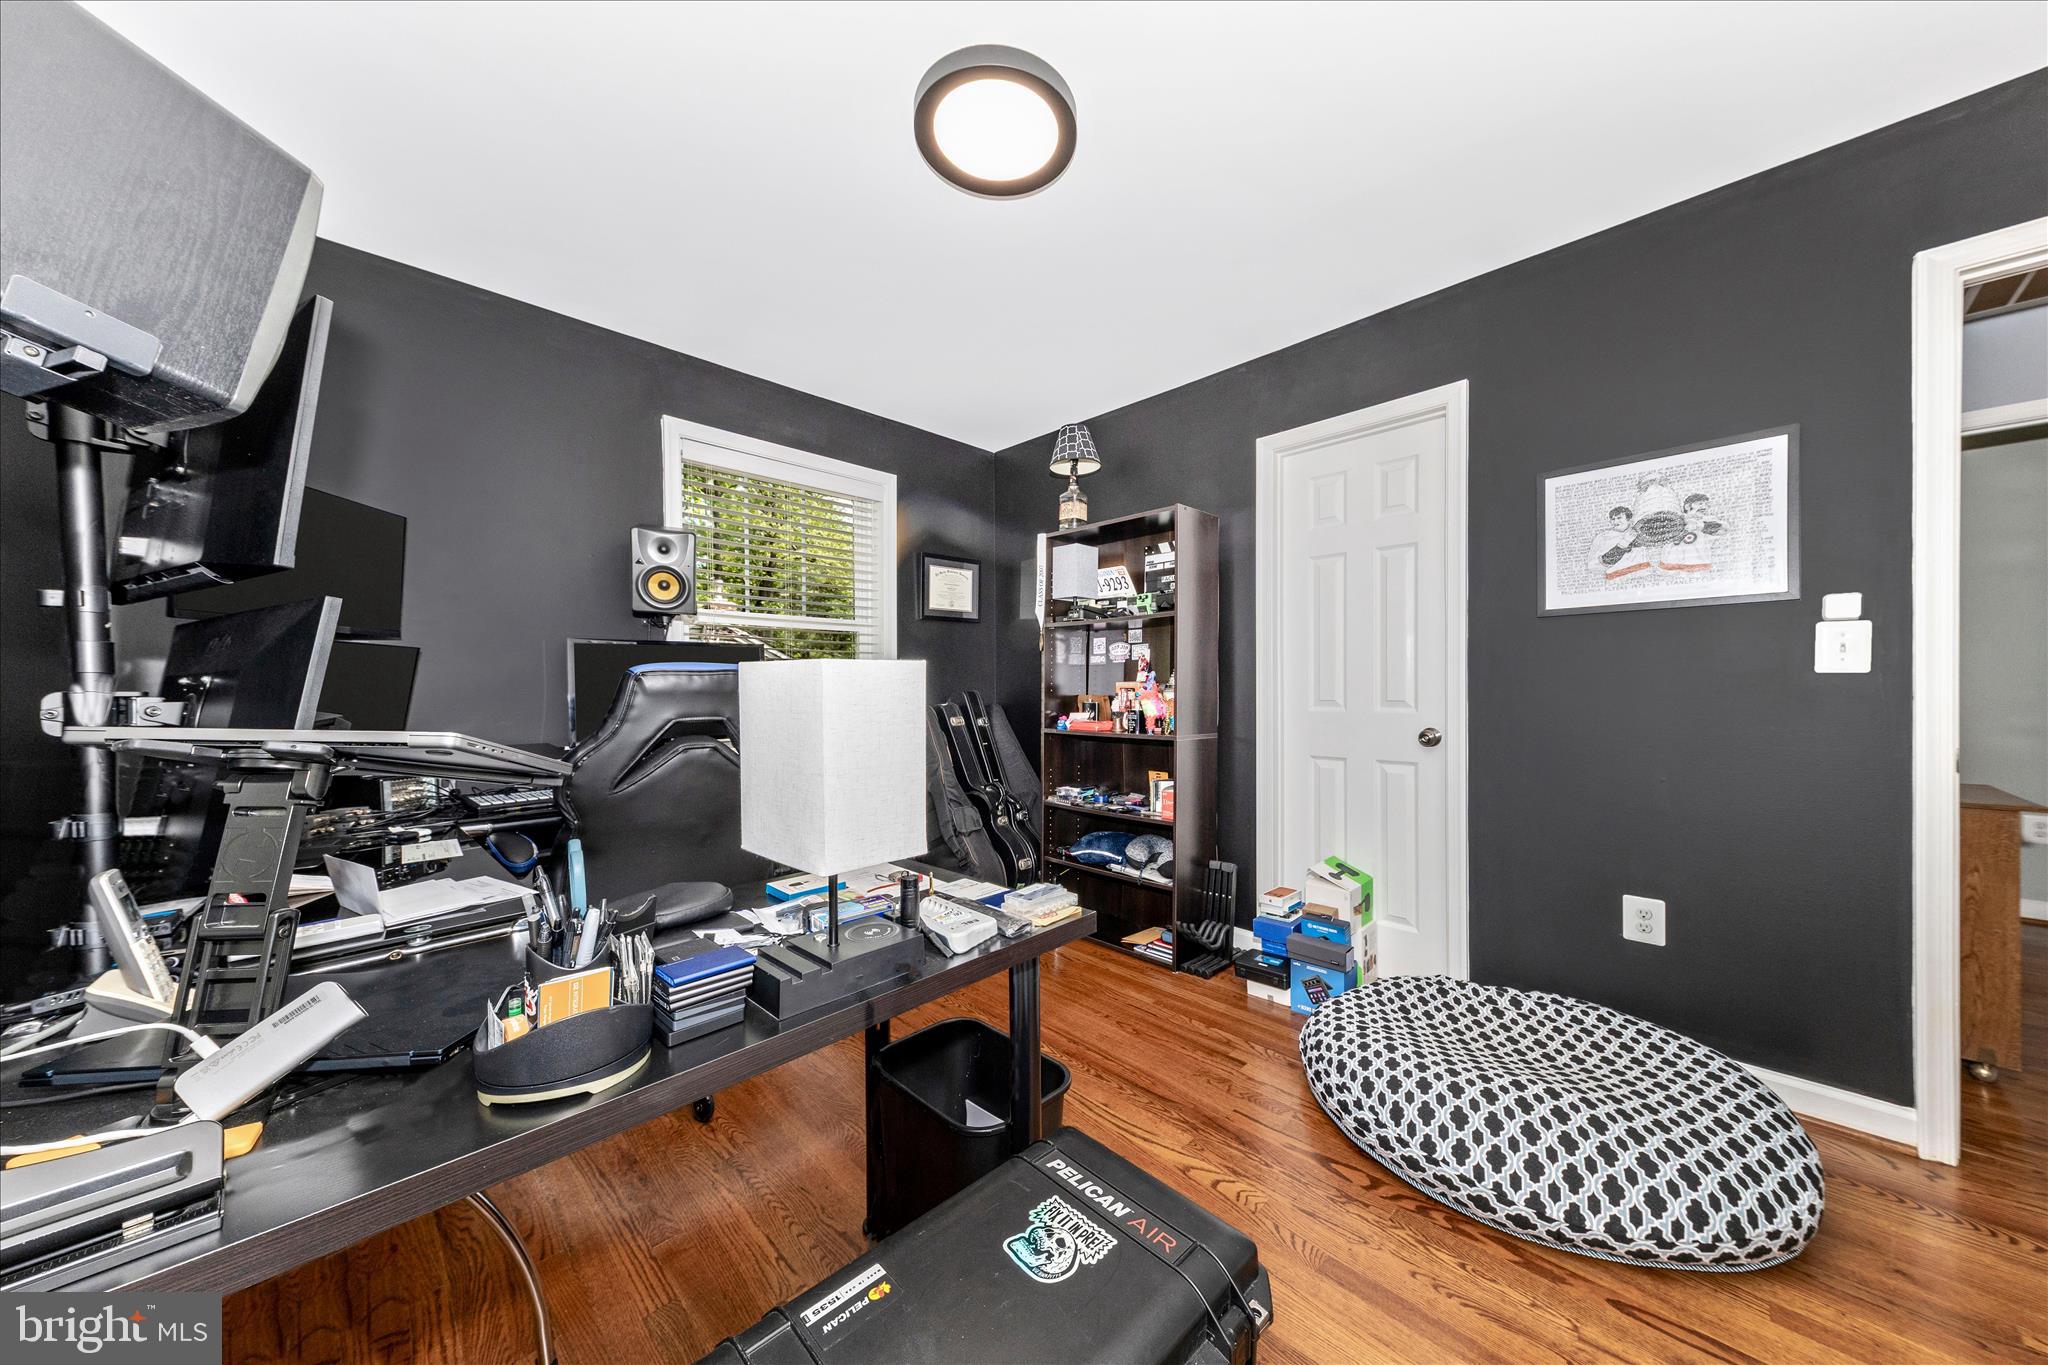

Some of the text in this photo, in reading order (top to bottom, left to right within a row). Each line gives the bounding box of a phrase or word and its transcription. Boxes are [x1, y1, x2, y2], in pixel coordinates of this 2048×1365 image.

[1046, 1159, 1177, 1253] PELICAN AIR
[1045, 1204, 1104, 1251] FIX IT IN PRE!
[811, 1295, 841, 1317] 1535
[822, 1296, 869, 1334] PELICAN
